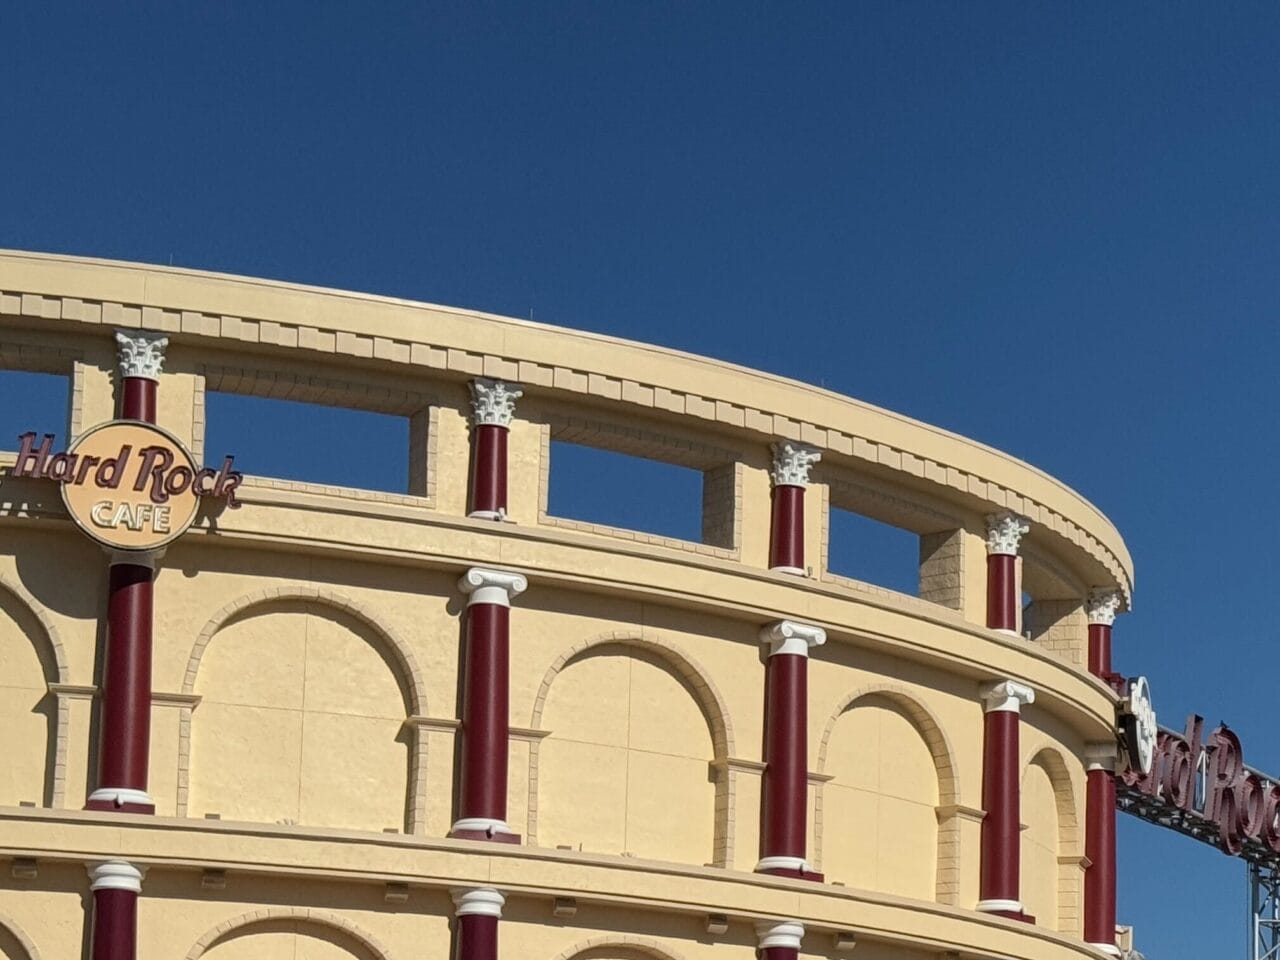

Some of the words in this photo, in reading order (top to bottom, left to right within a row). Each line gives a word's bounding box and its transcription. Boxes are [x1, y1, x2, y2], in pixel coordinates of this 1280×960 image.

[13, 432, 131, 488] Hard
[134, 446, 244, 508] Rock
[91, 501, 171, 534] CAFE
